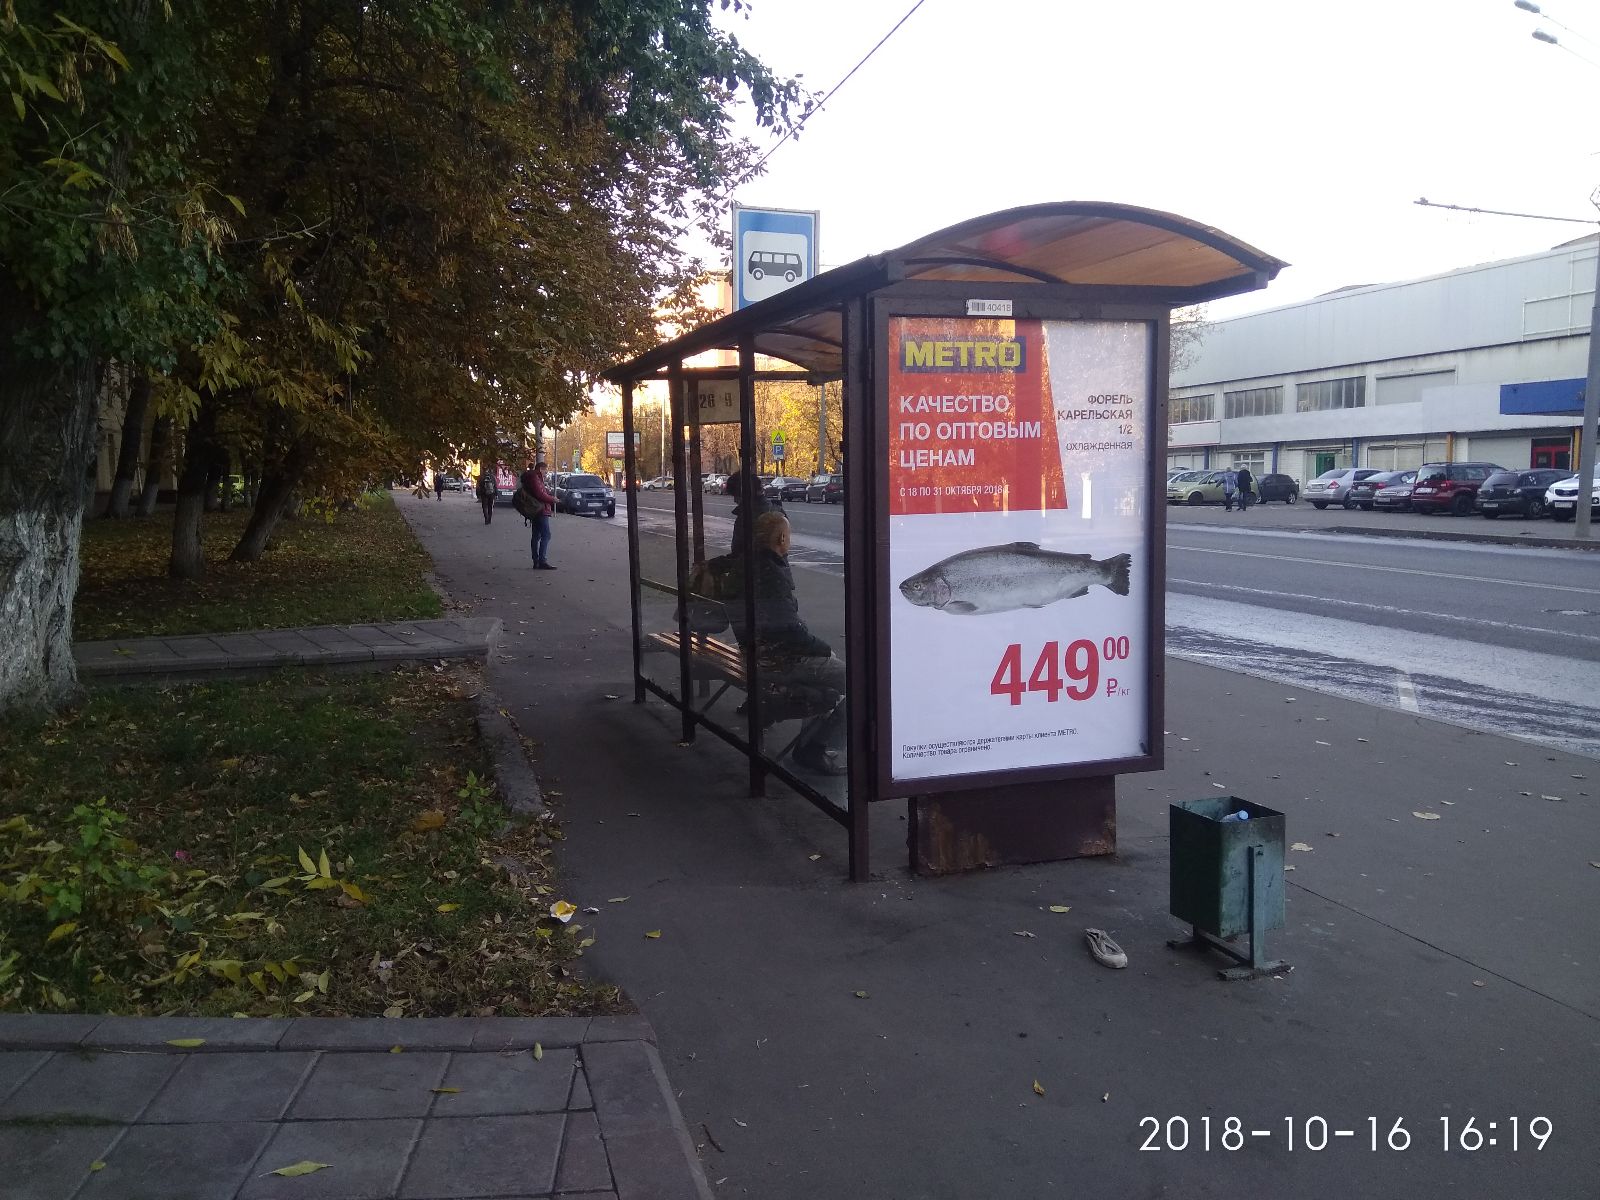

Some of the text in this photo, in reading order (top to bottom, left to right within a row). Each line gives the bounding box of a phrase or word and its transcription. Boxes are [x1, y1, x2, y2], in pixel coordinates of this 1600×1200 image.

[905, 341, 1021, 367] METRO
[900, 395, 1010, 413] КАЧЕСТВО
[1087, 394, 1133, 405] ФОРЕЛЬ
[1058, 409, 1133, 420] КАРЕЛЬСКАЯ
[900, 421, 1041, 440] ПО ОПТОВЫМ
[1118, 424, 1133, 435] 1/2
[1066, 441, 1133, 452] охлажденная
[900, 448, 975, 471] ЦЕНАМ
[900, 487, 906, 497] С
[908, 487, 918, 497] 18
[920, 487, 931, 496] ПО
[933, 486, 942, 496] 31
[945, 485, 982, 495] ОКТЯБРЯ
[990, 635, 1130, 705] 449 00
